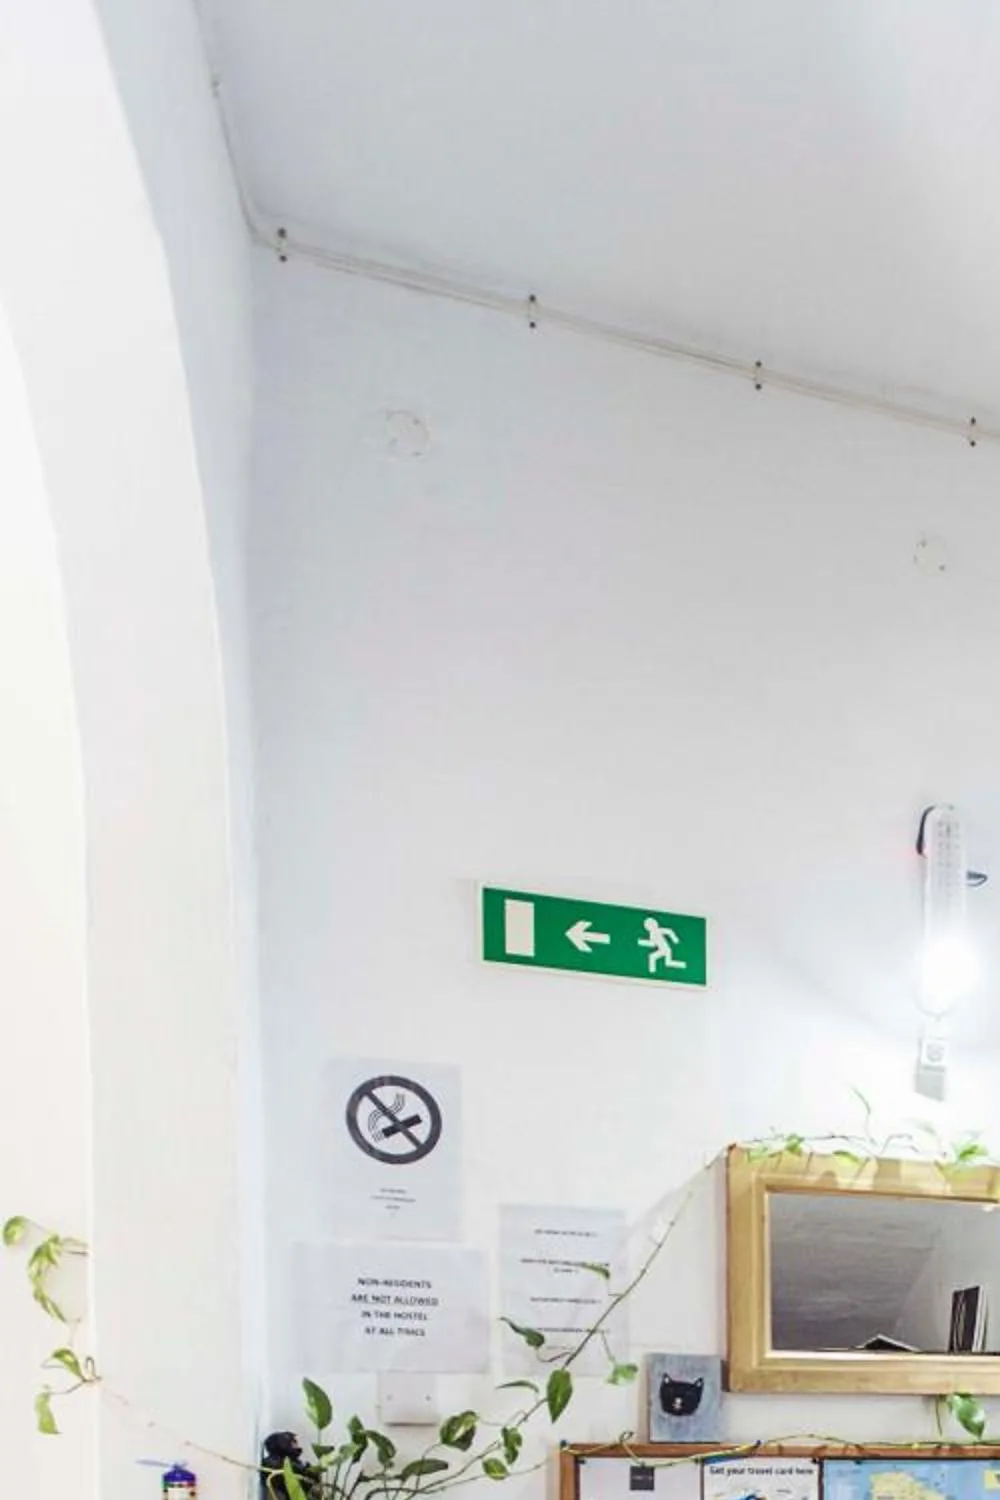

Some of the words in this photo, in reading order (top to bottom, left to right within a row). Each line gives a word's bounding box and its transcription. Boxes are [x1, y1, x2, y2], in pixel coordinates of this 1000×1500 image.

[357, 1277, 432, 1289] NON-RESIDENTS
[351, 1294, 368, 1303] ARE
[371, 1295, 391, 1305] NOT
[394, 1295, 438, 1306] ALLOWED
[374, 1310, 390, 1319] THE
[393, 1311, 427, 1321] HOSTEL
[379, 1326, 394, 1335] ALL
[710, 1466, 725, 1475] Get
[727, 1467, 745, 1477] your
[747, 1466, 773, 1475] travel
[775, 1467, 793, 1475] card
[796, 1467, 813, 1475] here
